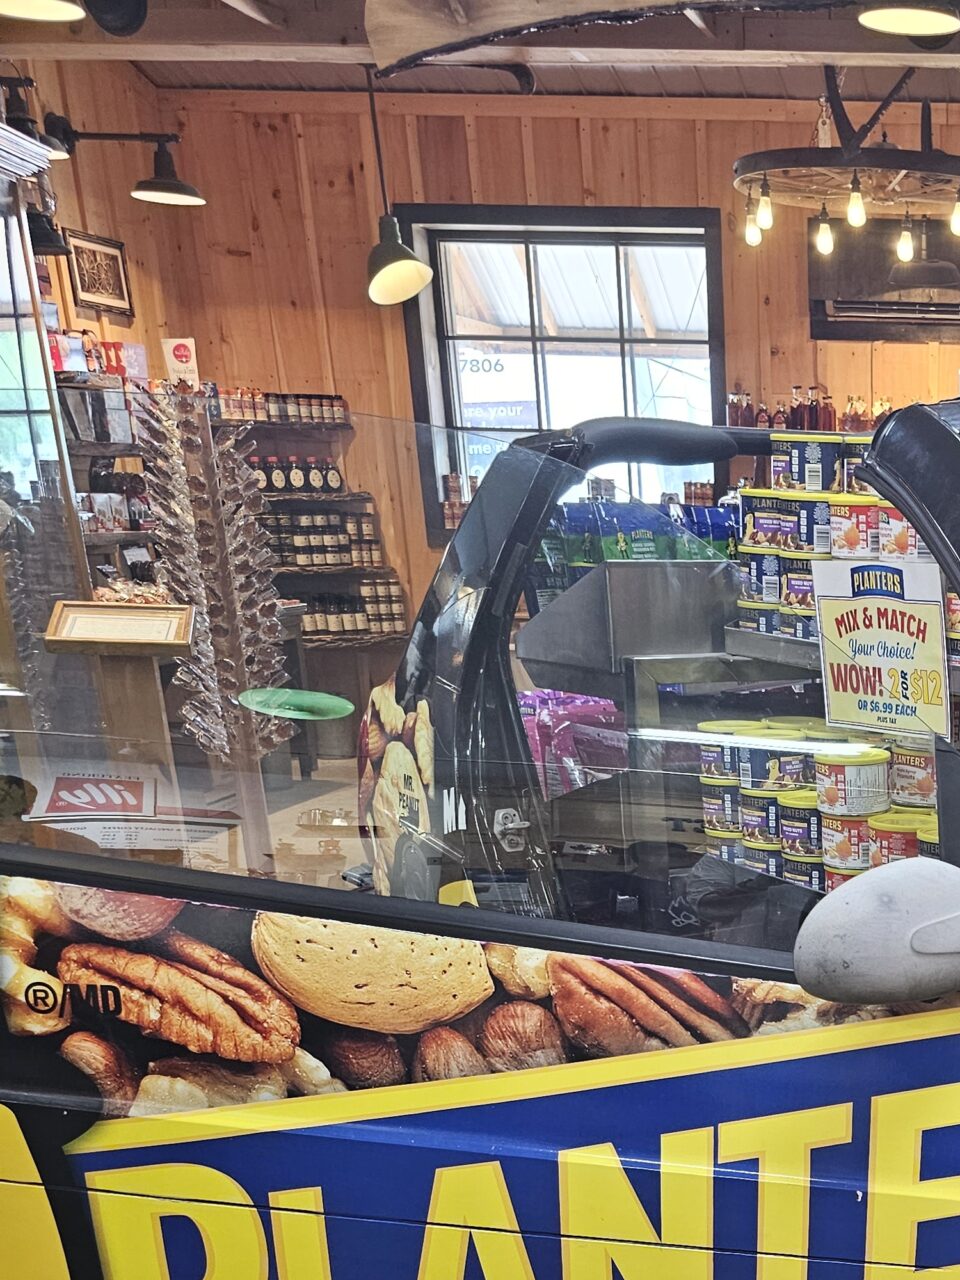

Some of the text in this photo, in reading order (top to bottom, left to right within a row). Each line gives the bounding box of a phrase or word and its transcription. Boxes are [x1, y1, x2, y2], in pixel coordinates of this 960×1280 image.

[853, 570, 902, 594] PLANTERS
[835, 607, 928, 643] MIX & MATCH
[848, 639, 917, 660] Your Choice!
[829, 662, 943, 706] WOW! 2 FOR $12
[858, 699, 917, 717] OR $6.99 EACH
